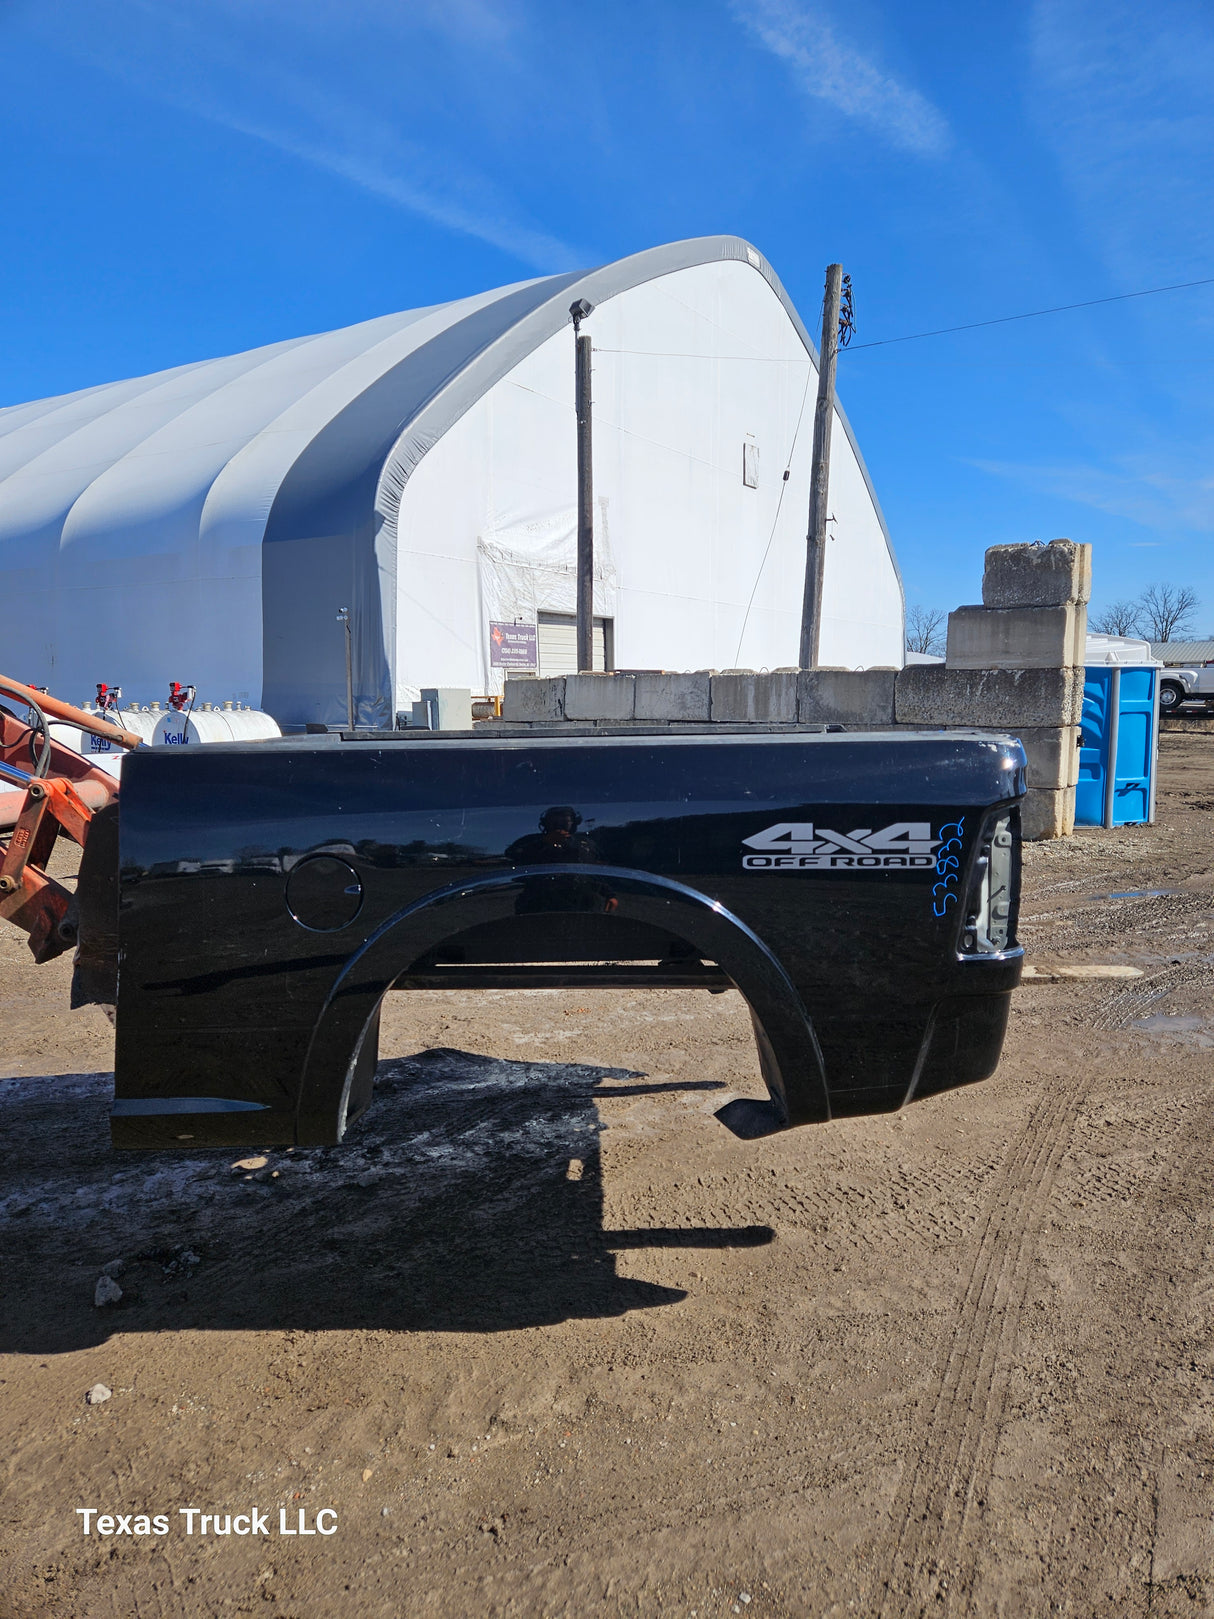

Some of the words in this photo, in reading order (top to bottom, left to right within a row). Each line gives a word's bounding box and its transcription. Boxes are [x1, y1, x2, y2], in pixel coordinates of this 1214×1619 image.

[746, 856, 821, 867] OFF
[830, 856, 934, 867] ROAD
[932, 816, 965, 917] 53832
